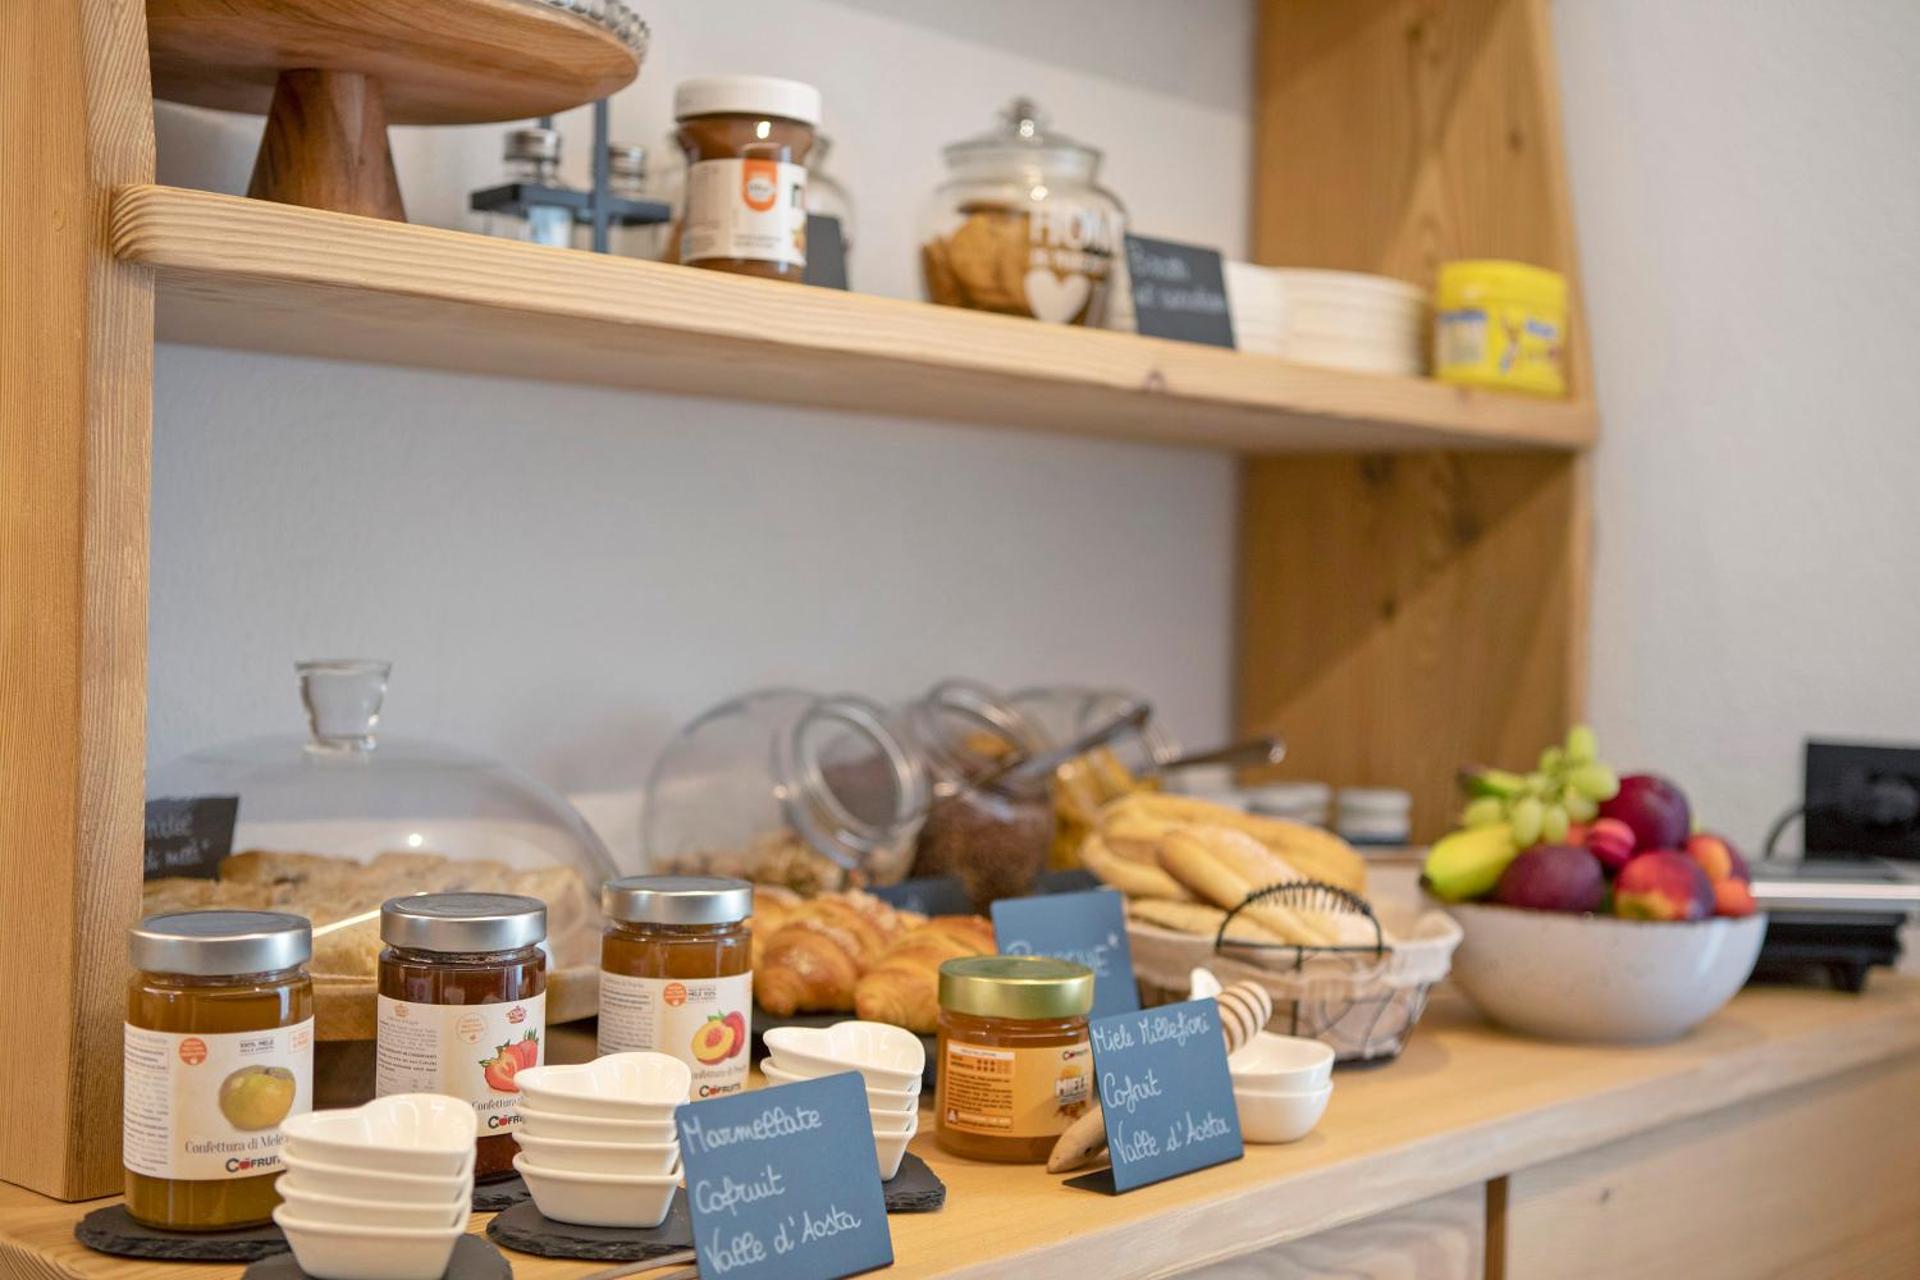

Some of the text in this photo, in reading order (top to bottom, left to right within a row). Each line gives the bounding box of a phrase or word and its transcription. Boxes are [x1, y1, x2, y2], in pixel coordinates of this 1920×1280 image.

[1092, 1023, 1135, 1053] Miele
[184, 1139, 246, 1154] Confettura
[247, 1135, 259, 1150] di
[682, 1106, 823, 1155] Marmellate
[1114, 1111, 1232, 1165] Valle d'Aosta
[695, 1165, 786, 1217] Cofruit
[705, 1204, 861, 1274] Valle d'Aosta
